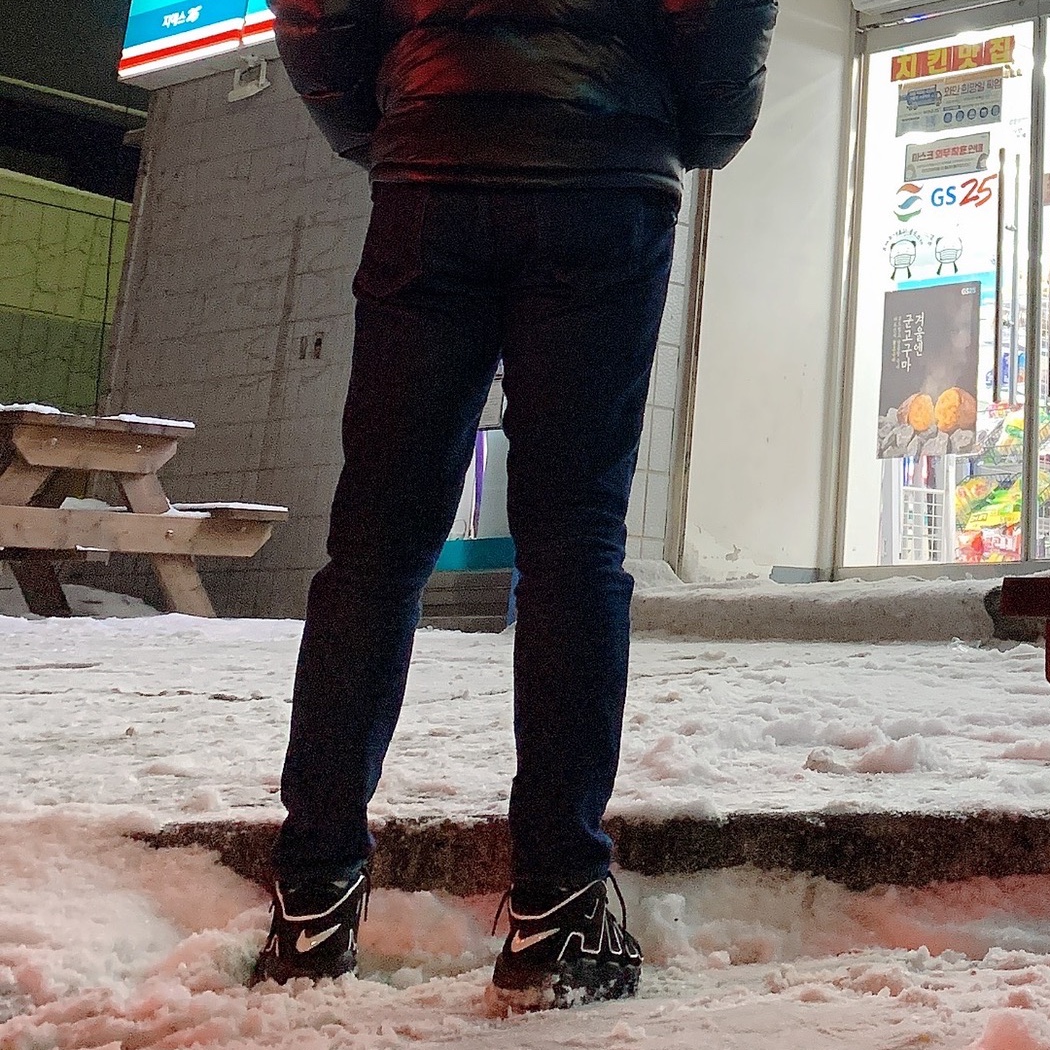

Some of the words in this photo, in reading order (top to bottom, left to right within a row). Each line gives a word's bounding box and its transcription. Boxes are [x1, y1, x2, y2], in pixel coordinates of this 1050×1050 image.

[912, 150, 934, 162] 마스크
[930, 174, 998, 208] GS25
[901, 313, 914, 373] 군고구마
[913, 311, 926, 357] 겨울엔
